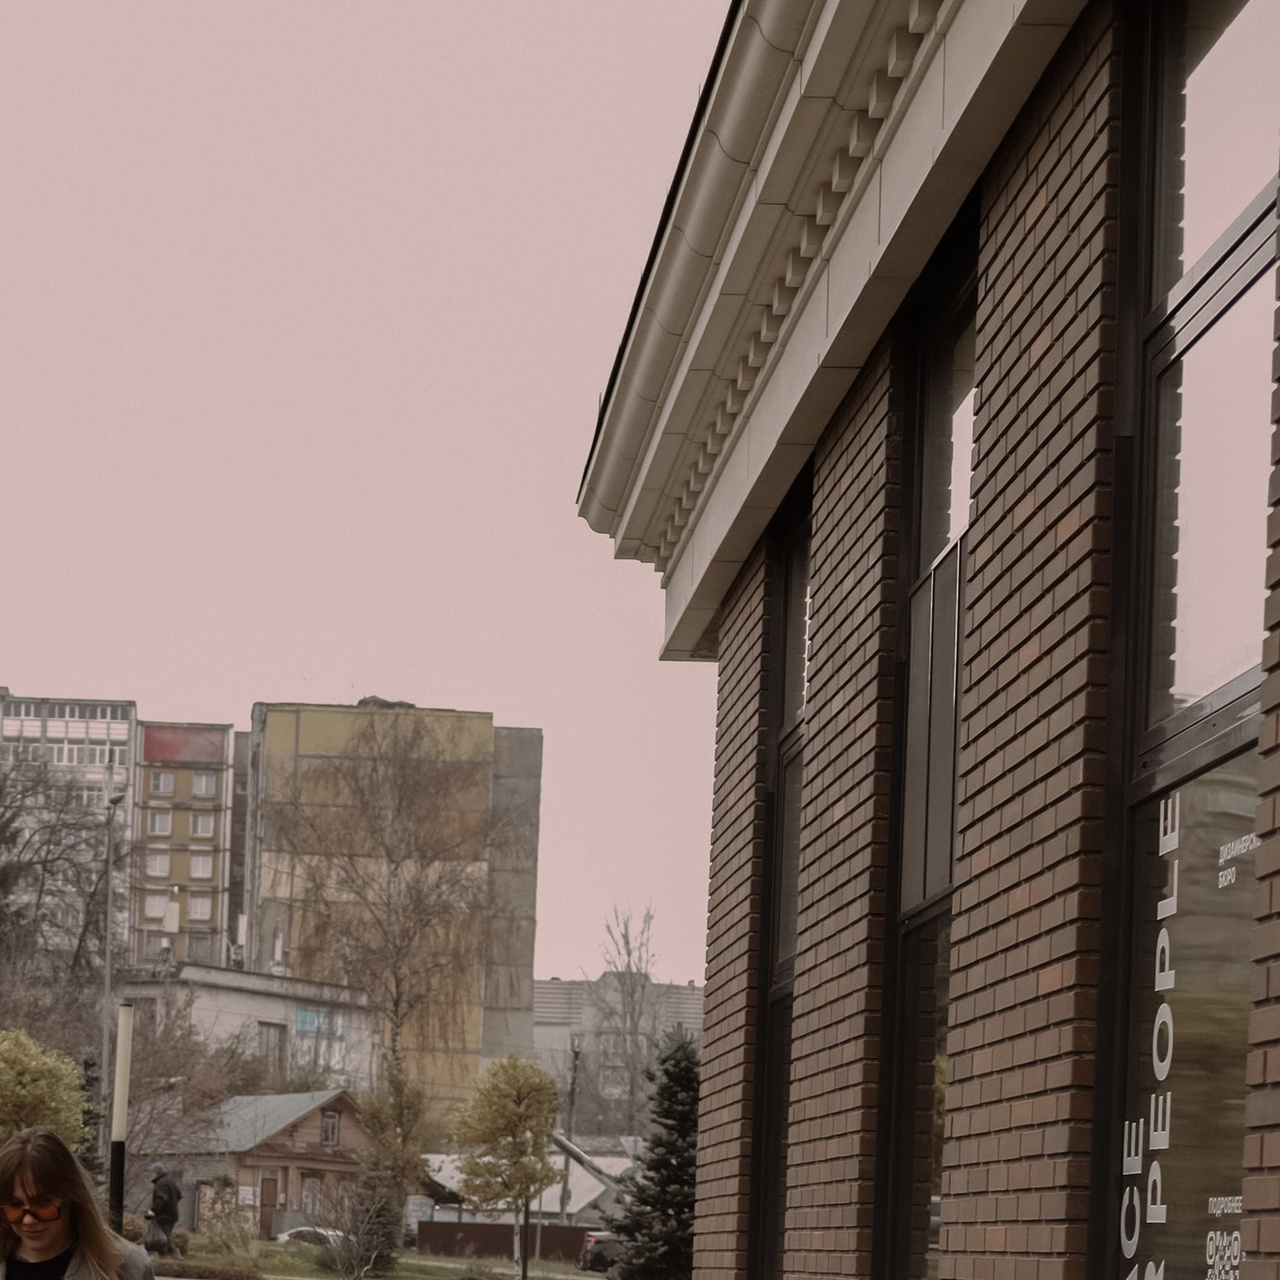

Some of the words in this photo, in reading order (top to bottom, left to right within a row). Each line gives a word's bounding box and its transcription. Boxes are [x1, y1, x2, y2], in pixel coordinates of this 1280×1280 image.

[1218, 866, 1236, 888] БЮРО
[1146, 791, 1181, 1224] PEOPLE
[1208, 1196, 1243, 1218] ПОДРОБНЕЕ
